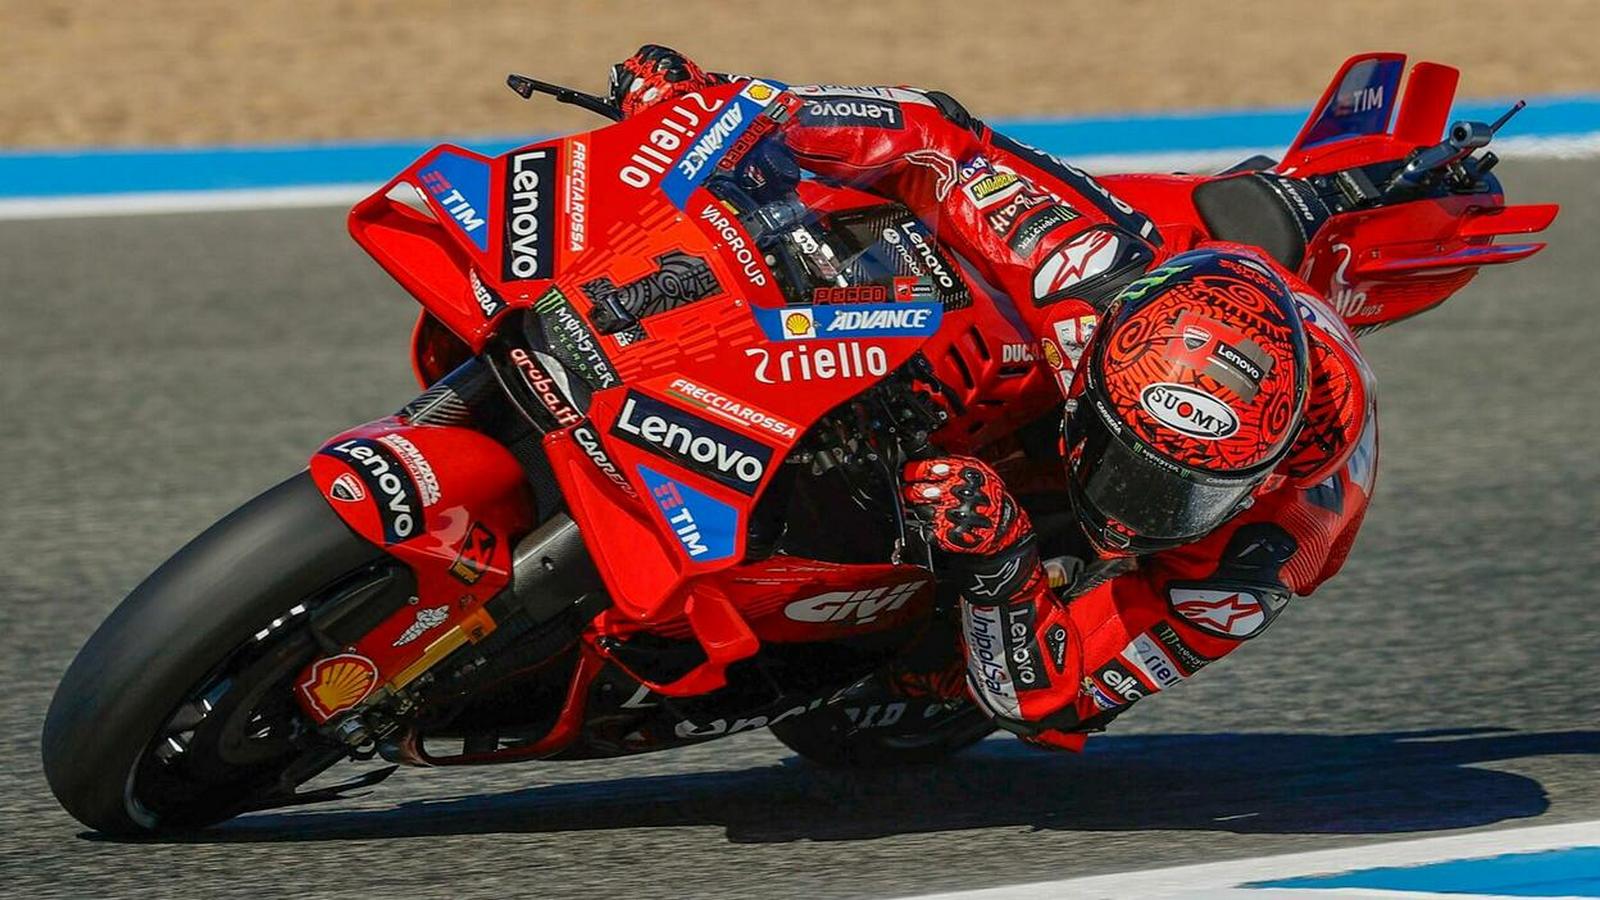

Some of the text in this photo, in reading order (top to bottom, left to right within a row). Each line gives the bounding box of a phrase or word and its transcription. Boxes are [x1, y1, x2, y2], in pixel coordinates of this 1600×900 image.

[810, 101, 896, 124] Lenovo
[1353, 85, 1384, 114] TIM
[619, 105, 699, 189] riello
[678, 102, 744, 181] ADVANCE
[442, 189, 486, 233] TIM
[511, 151, 546, 278] Lenovo
[569, 140, 587, 252] FRECCIAROSSA
[701, 204, 768, 288] VARGROUP
[901, 221, 954, 288] Lenovo
[555, 306, 615, 389] MONSTER
[826, 308, 932, 332] ADVANCE
[510, 348, 579, 425] aruba.it
[780, 341, 887, 382] riello
[1217, 344, 1260, 380] Lenovo
[616, 398, 763, 483] Lenovo
[670, 378, 799, 440] FRECCIAROSSA
[1151, 386, 1229, 437] SUOMY
[333, 440, 414, 538] Lenovo
[574, 427, 638, 499] CARRERA
[671, 507, 709, 557] TIM
[784, 580, 928, 625] GIVI
[1009, 608, 1036, 684] Lenovo
